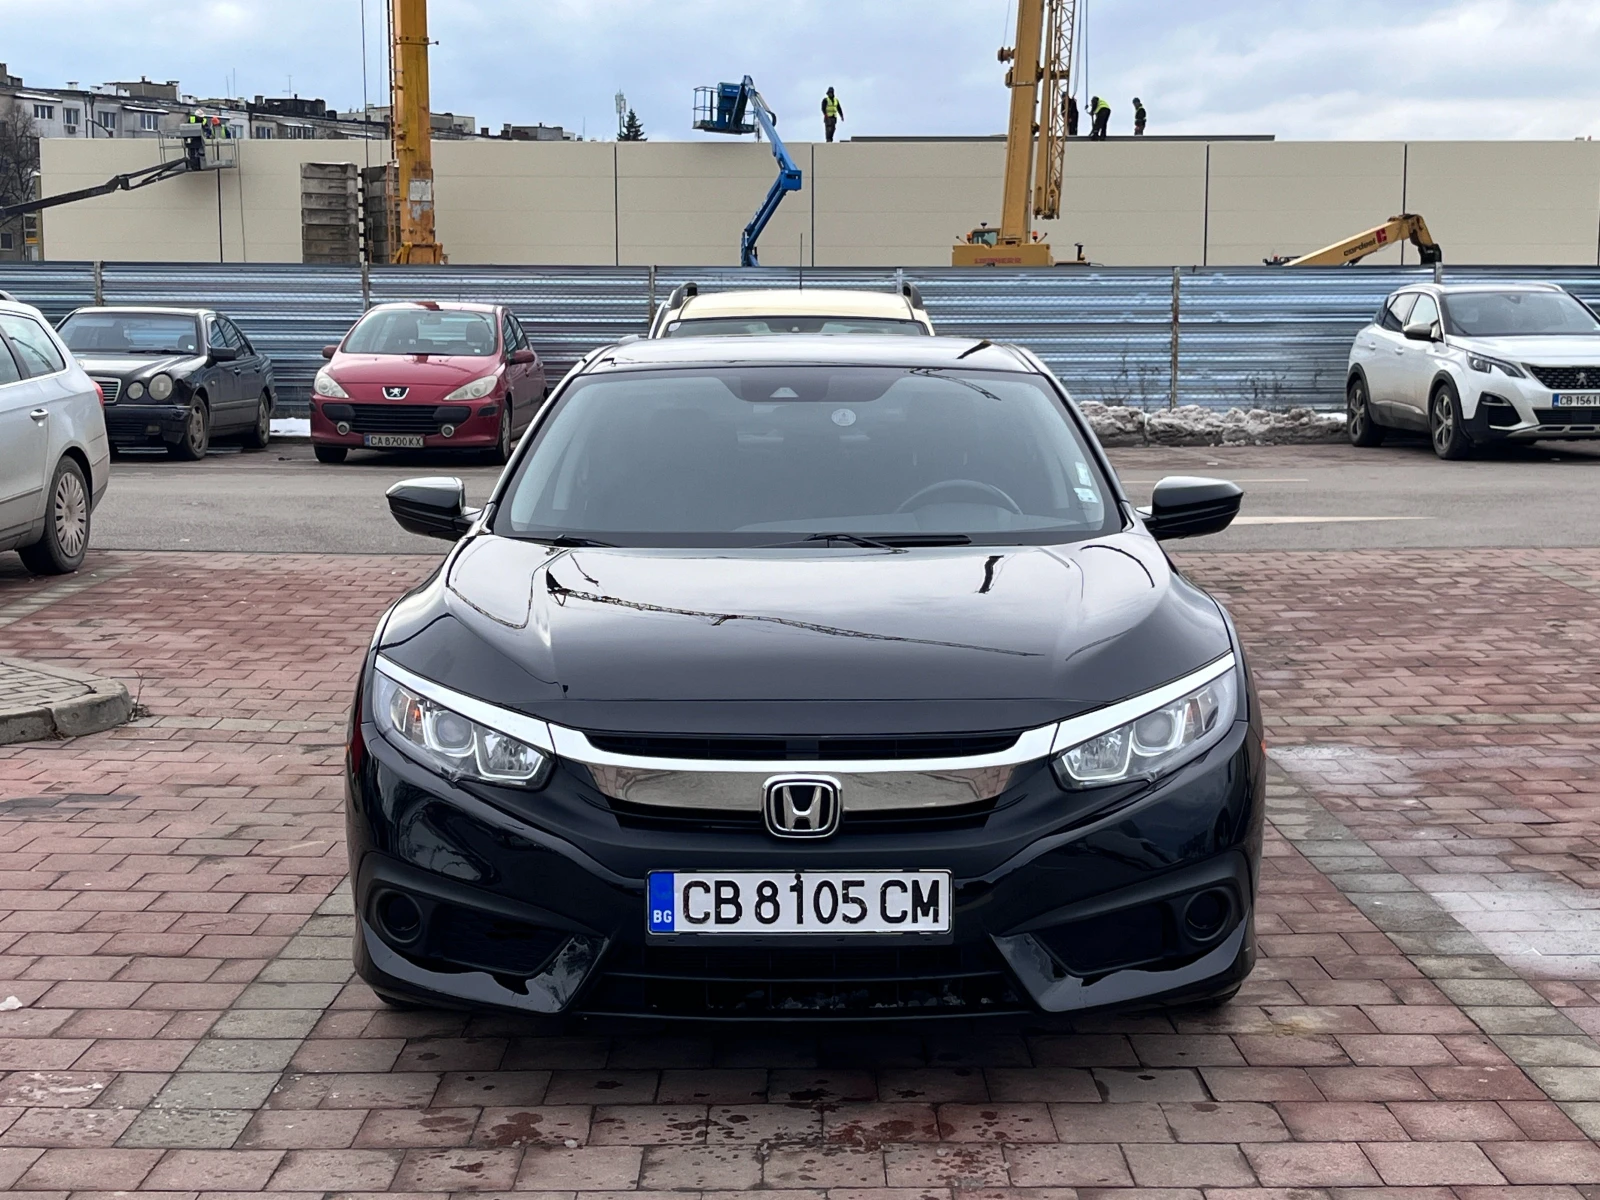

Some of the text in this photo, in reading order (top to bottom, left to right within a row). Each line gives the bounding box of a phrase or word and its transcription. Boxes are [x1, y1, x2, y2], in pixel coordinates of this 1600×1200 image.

[1560, 395, 1573, 406] CB
[1575, 395, 1597, 406] 1561
[370, 436, 422, 447] CA 8700 KX
[682, 879, 941, 925] CB 8105 CM
[653, 909, 673, 924] BG
